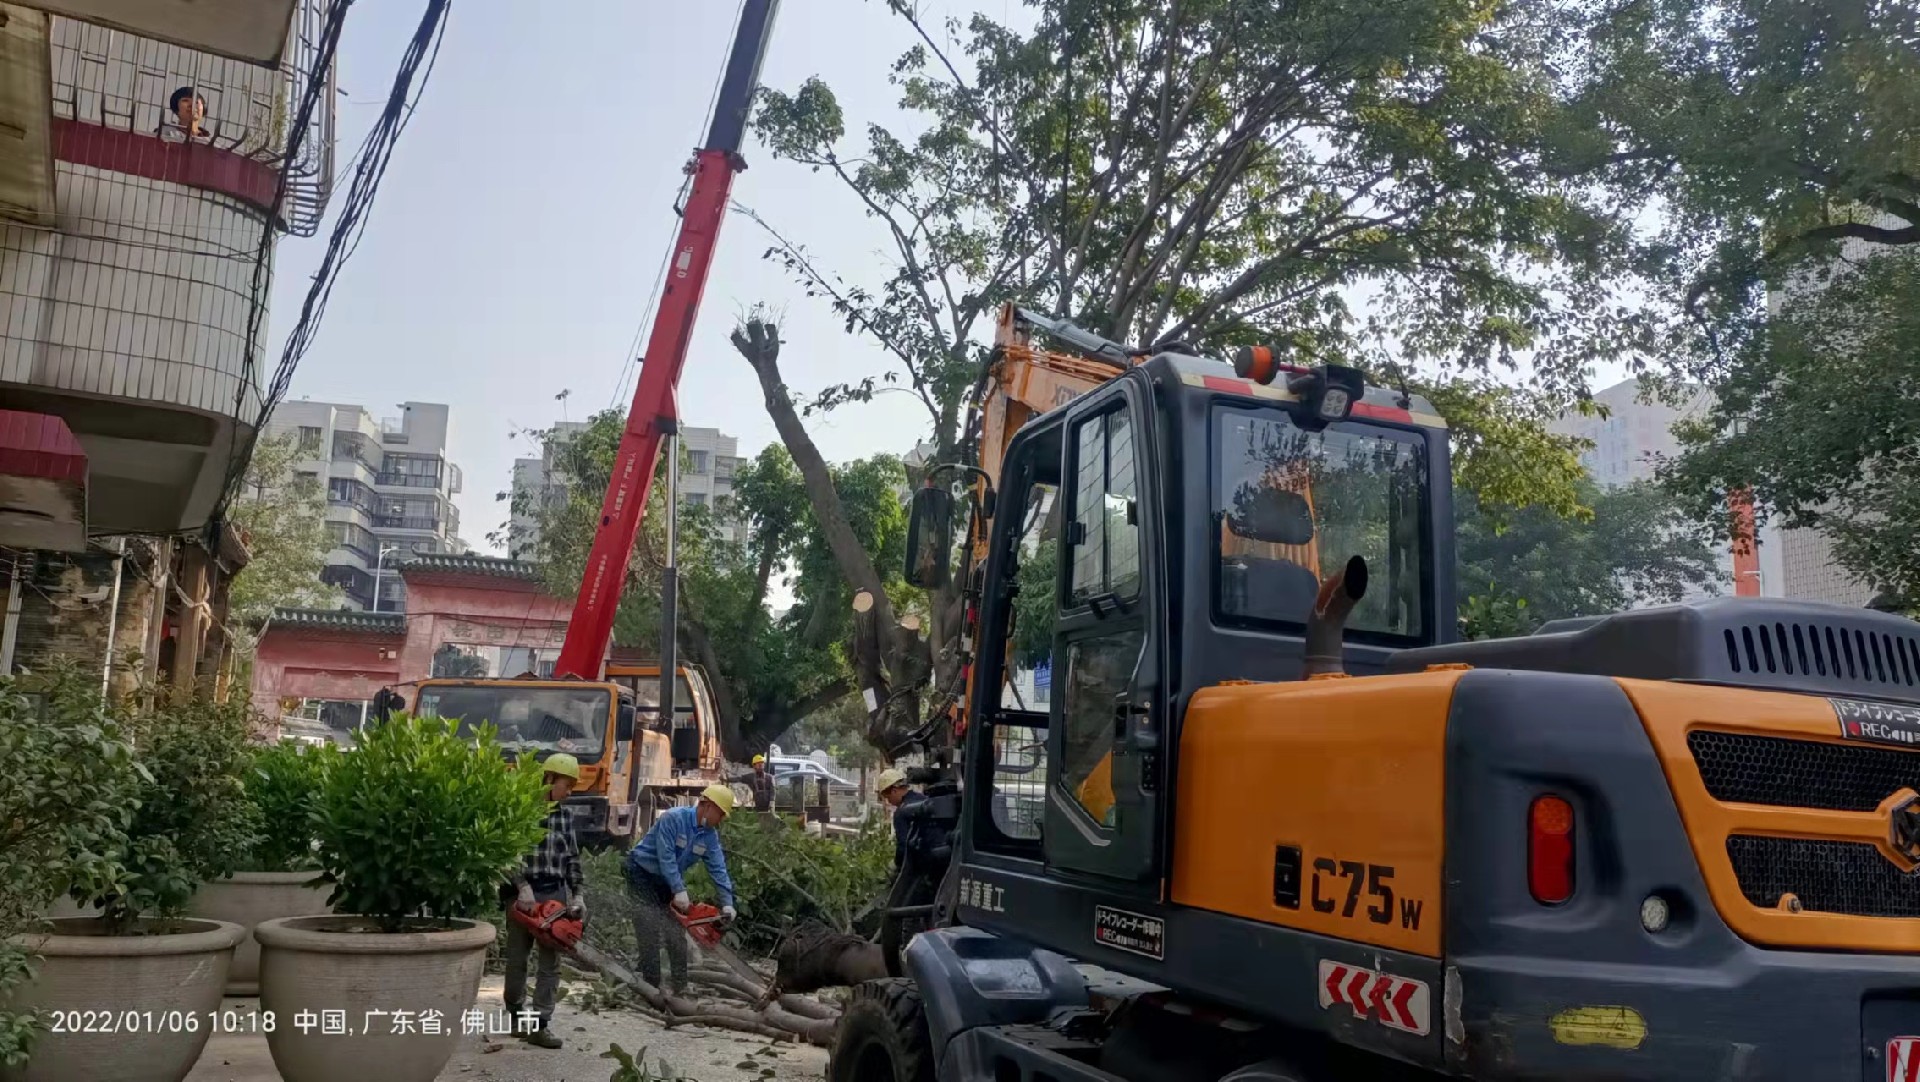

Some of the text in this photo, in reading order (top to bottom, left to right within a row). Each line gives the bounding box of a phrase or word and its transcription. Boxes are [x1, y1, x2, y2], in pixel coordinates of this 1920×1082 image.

[1860, 722, 1892, 739] REC
[959, 877, 1005, 912] 新源重工
